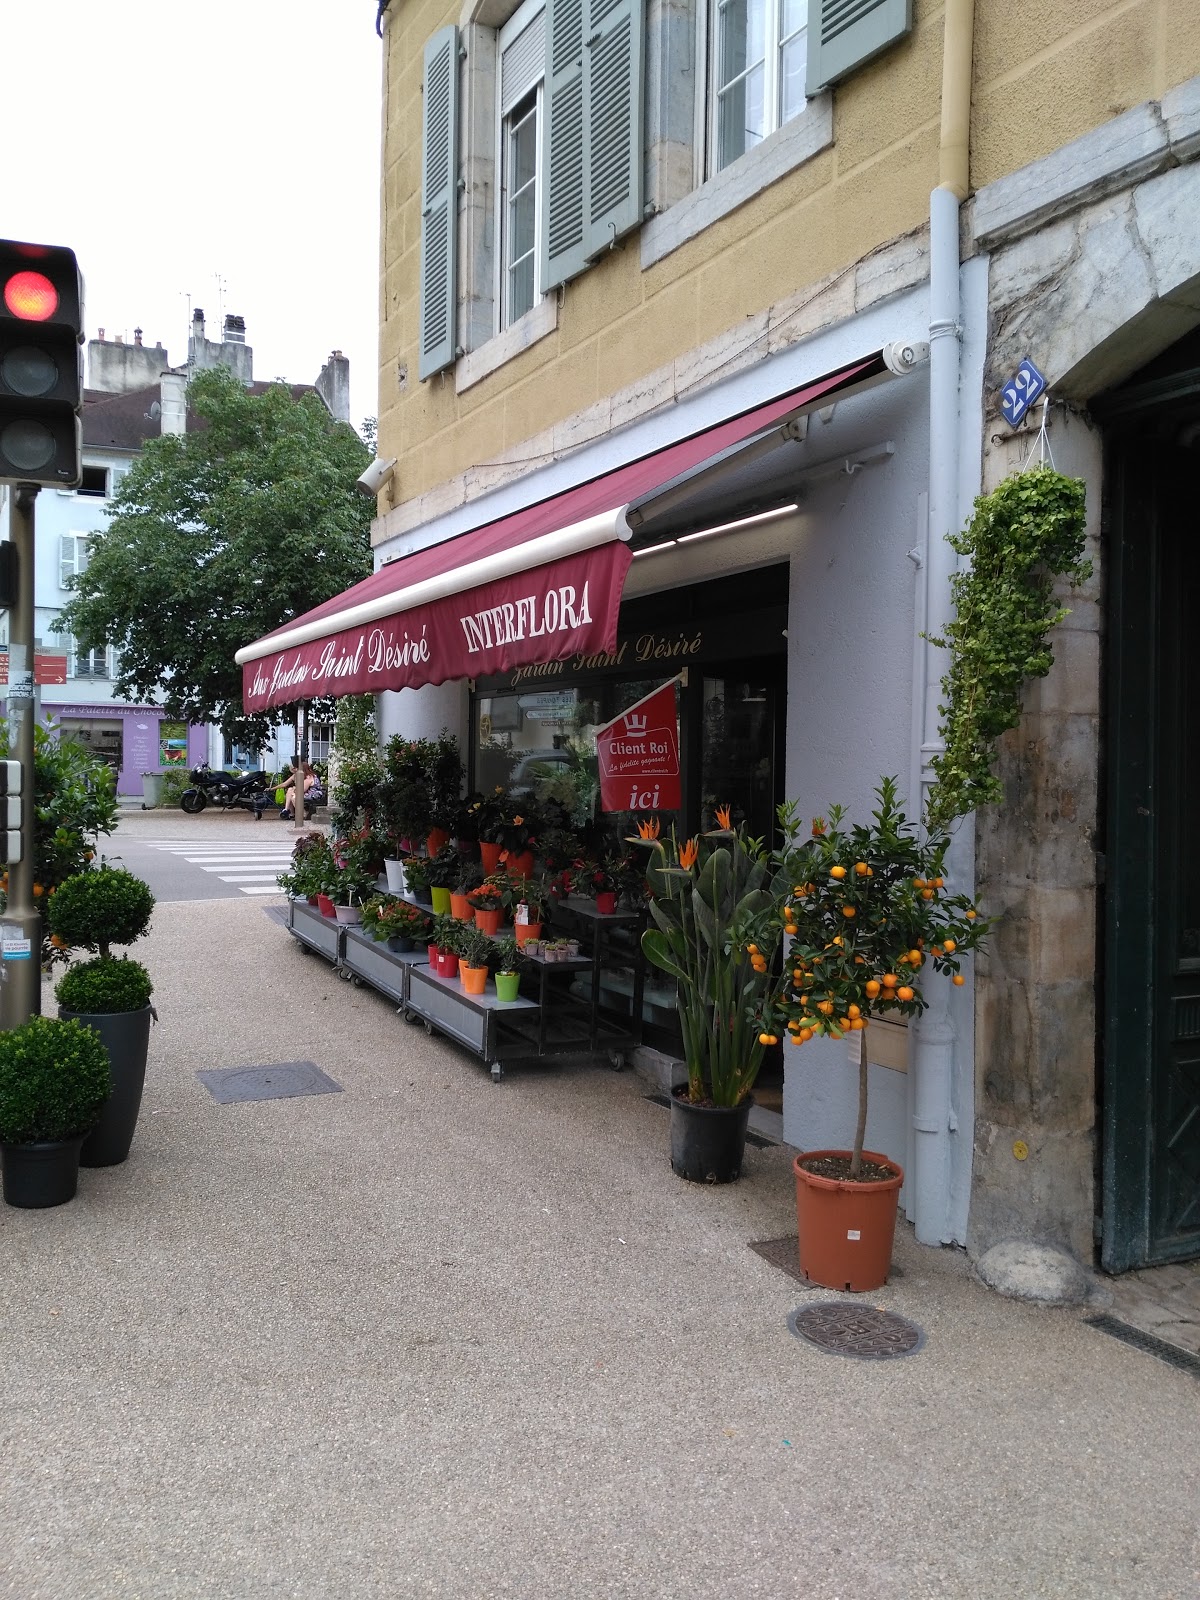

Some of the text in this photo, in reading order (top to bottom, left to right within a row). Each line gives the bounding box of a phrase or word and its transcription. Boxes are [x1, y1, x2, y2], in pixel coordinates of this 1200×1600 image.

[1002, 369, 1039, 419] 22
[460, 580, 592, 653] INTERFLORA
[635, 632, 702, 662] Désiré
[266, 653, 312, 703] Jardins
[312, 635, 365, 680] Saint
[368, 624, 431, 673] Désiré
[62, 706, 76, 714] La
[79, 707, 115, 715] Palette
[609, 741, 668, 755] Client Roi
[629, 784, 660, 810] ici
